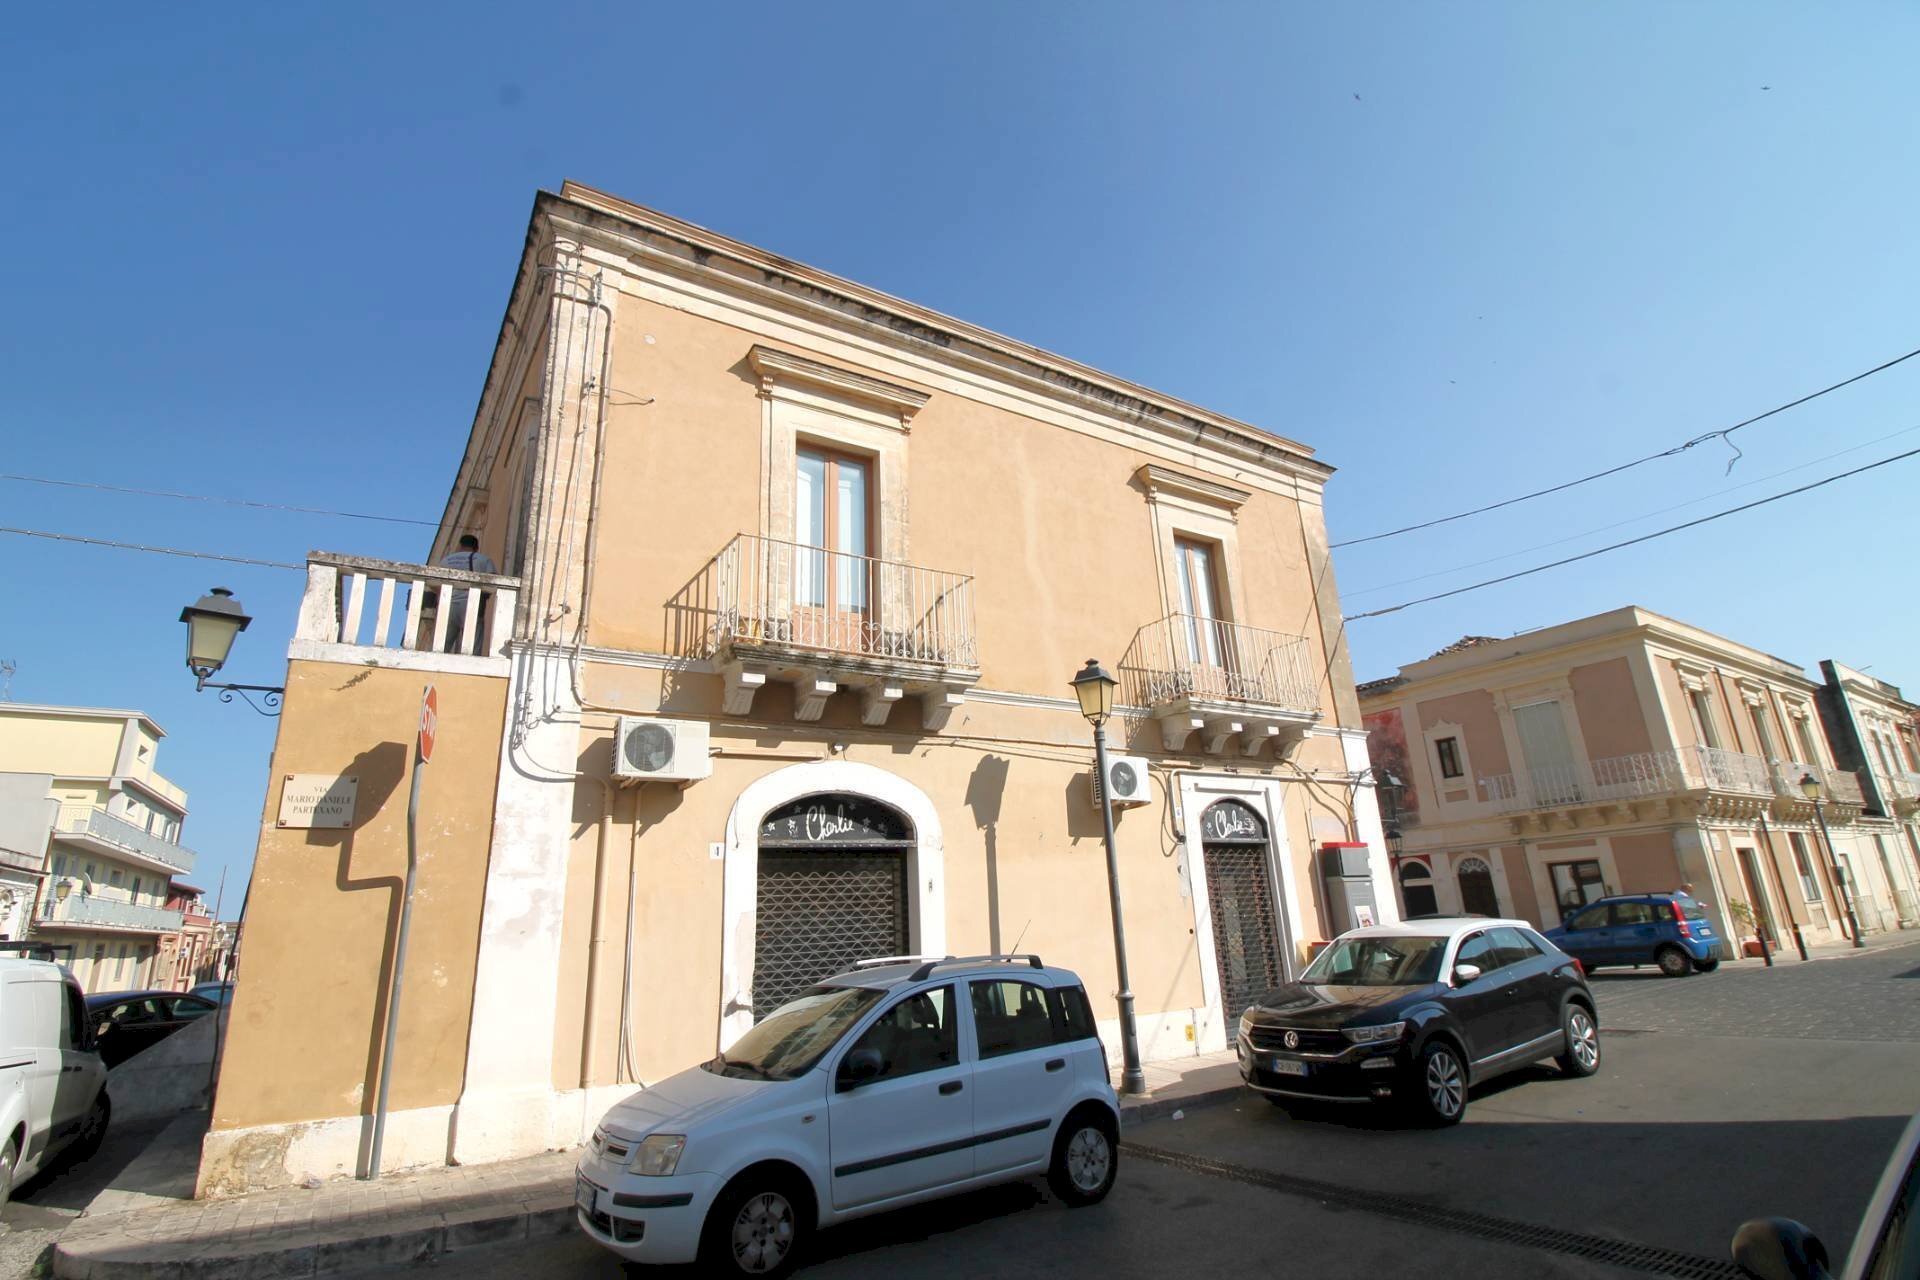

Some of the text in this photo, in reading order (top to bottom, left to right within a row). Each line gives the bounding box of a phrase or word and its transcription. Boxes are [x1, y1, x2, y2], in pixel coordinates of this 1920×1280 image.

[286, 795, 351, 805] MARIO DANIELE
[806, 804, 854, 841] Charlie
